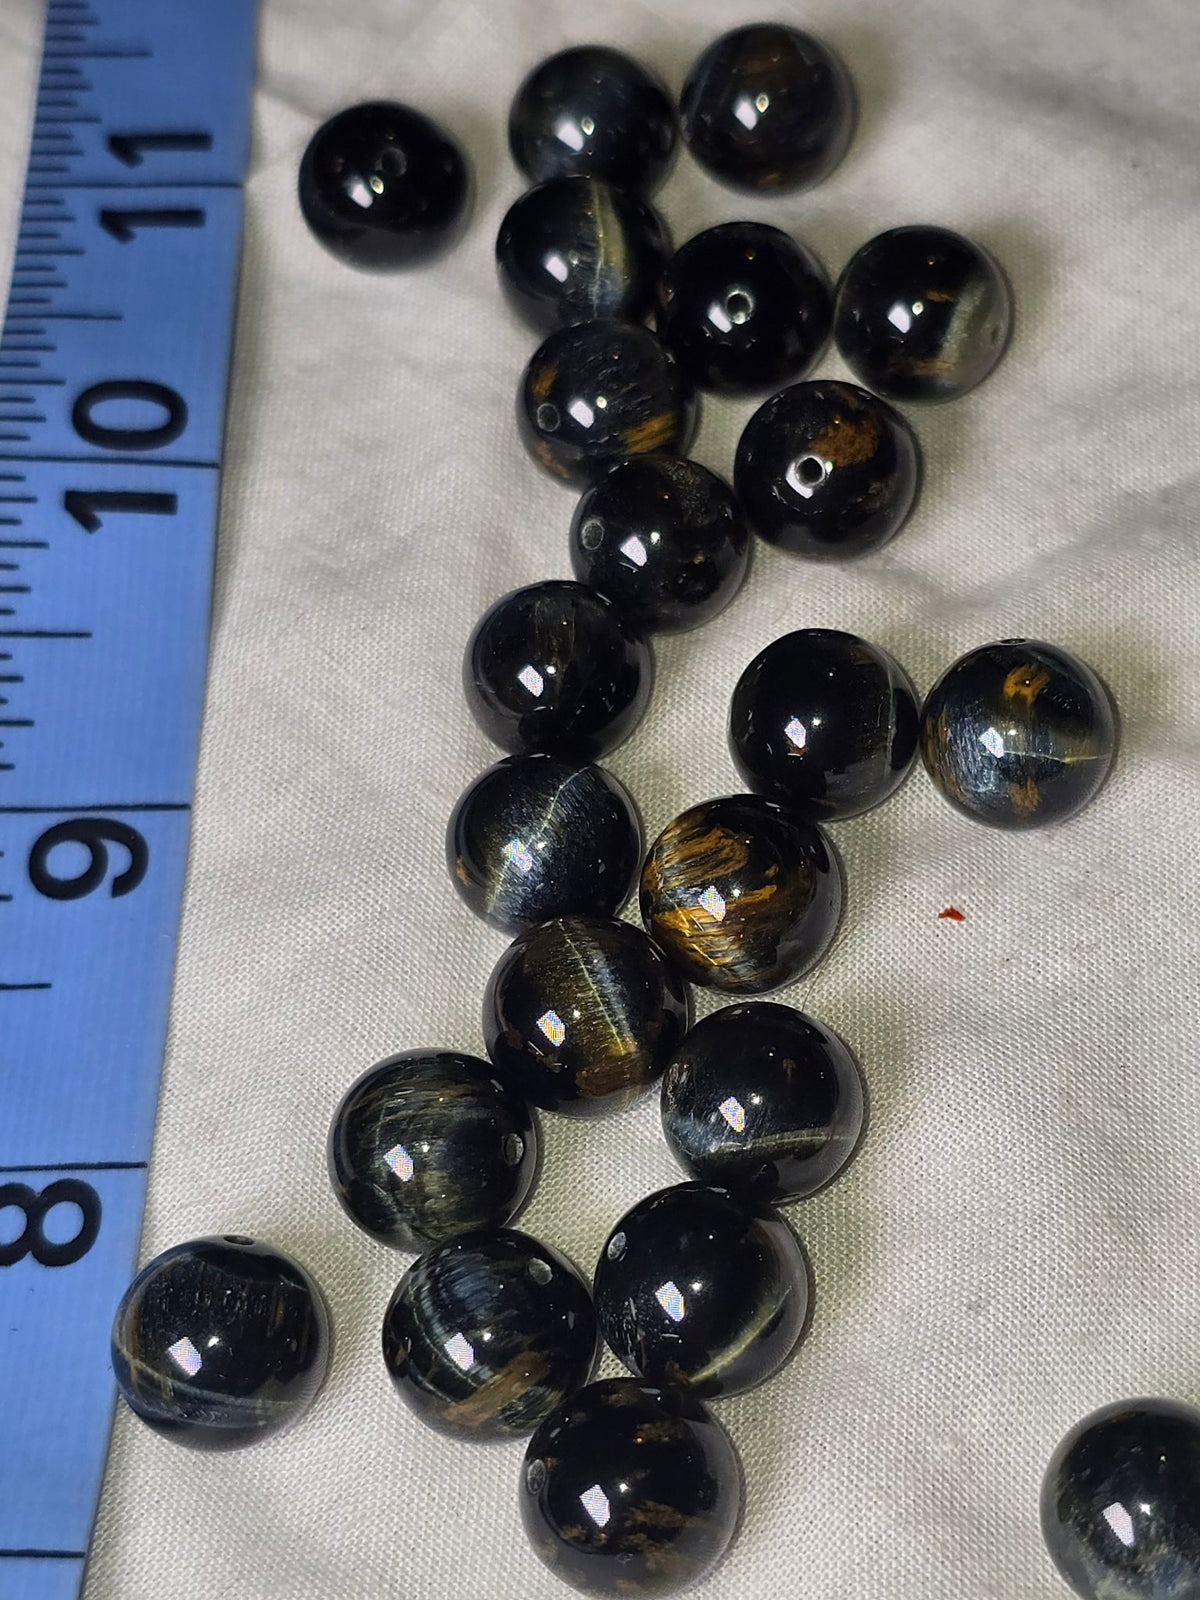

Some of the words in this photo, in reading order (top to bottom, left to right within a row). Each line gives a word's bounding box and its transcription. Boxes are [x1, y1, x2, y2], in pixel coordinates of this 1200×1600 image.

[101, 131, 213, 243] 11
[64, 379, 189, 534] 10
[28, 817, 149, 900] 9
[0, 1178, 102, 1267] 8
